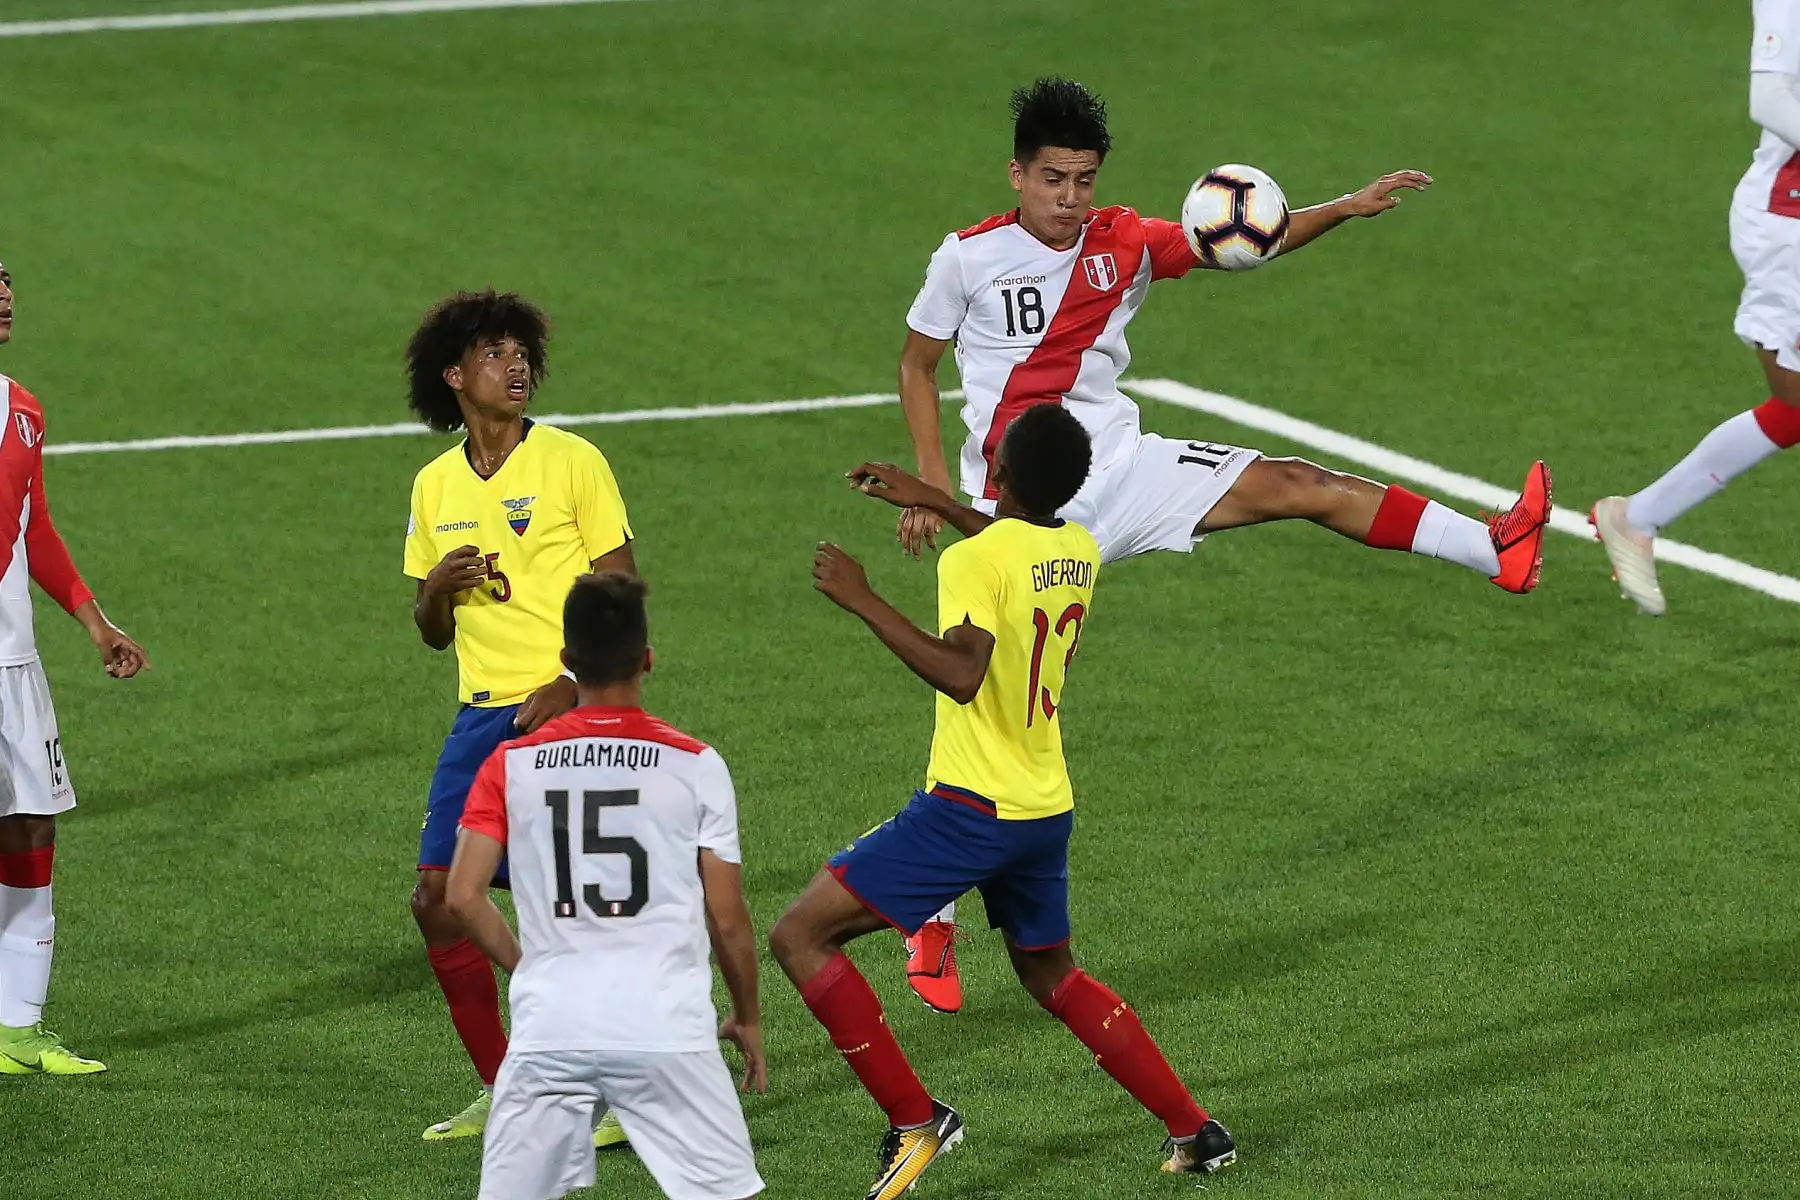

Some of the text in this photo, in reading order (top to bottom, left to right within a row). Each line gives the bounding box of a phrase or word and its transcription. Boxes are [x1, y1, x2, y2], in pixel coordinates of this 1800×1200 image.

[992, 274, 1046, 287] marathon
[1001, 286, 1045, 337] 18
[435, 520, 479, 533] marathon
[1026, 602, 1085, 729] 13
[535, 743, 660, 771] BURLAMAQUI
[545, 789, 649, 917] 15
